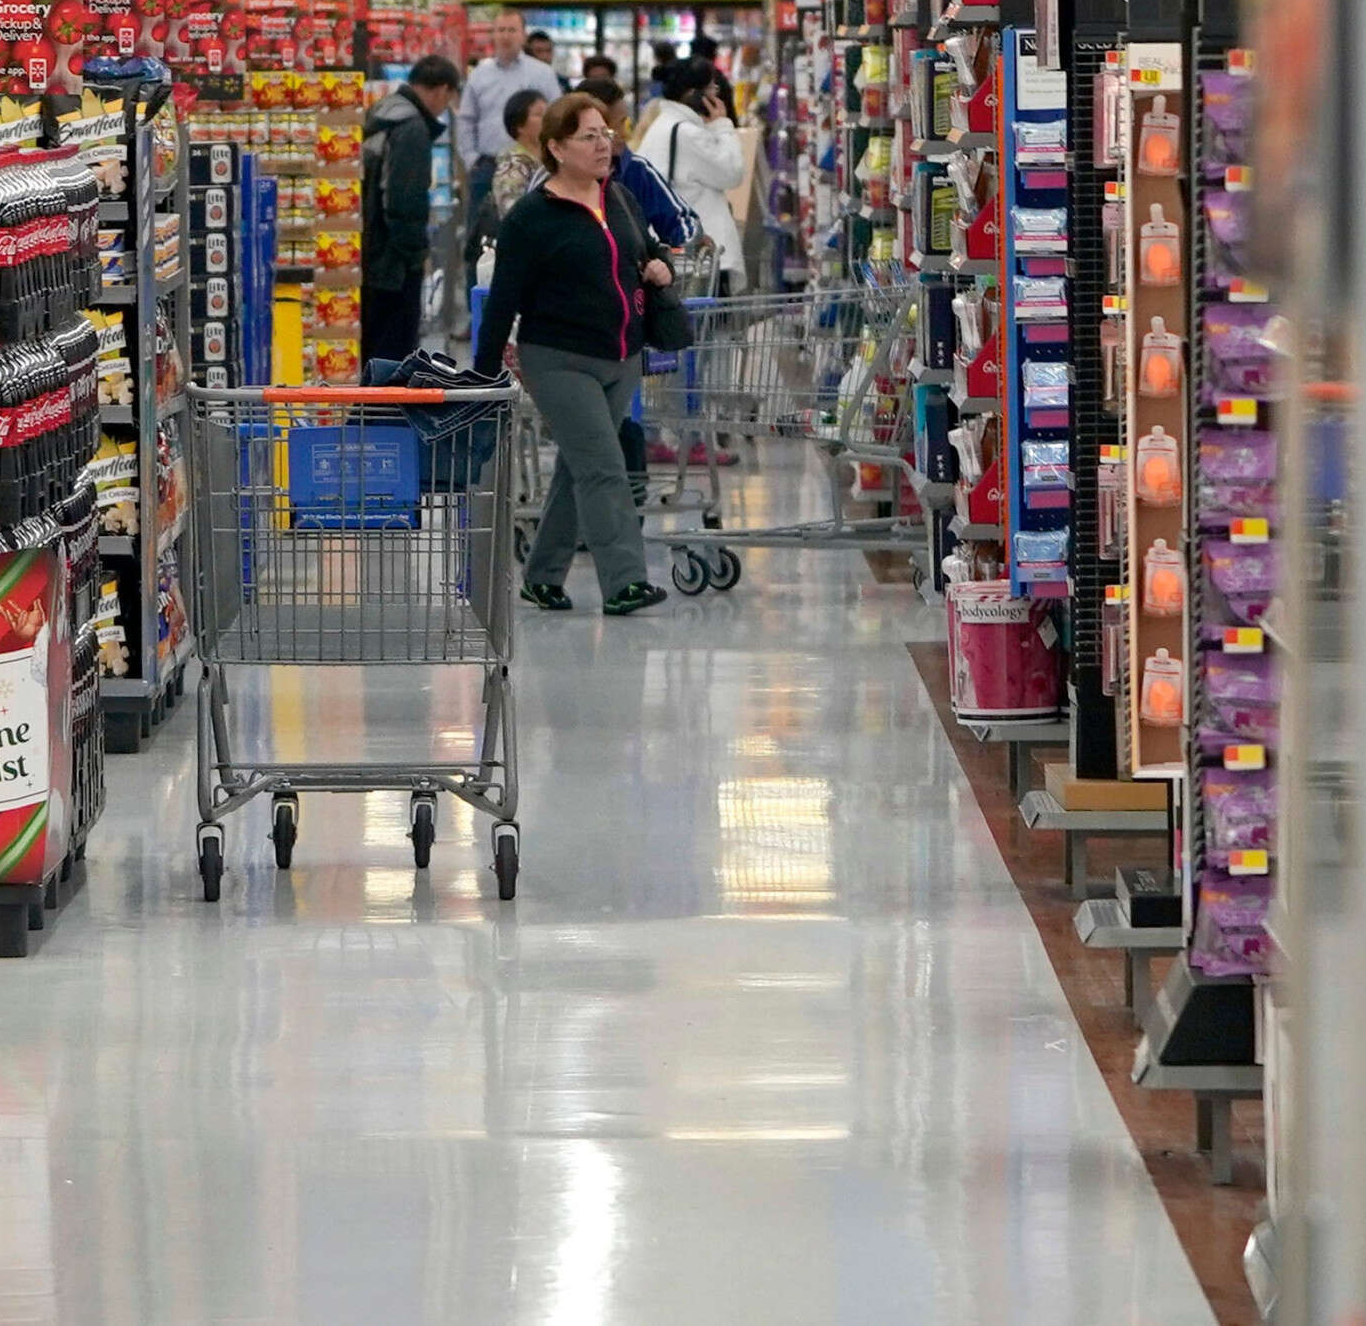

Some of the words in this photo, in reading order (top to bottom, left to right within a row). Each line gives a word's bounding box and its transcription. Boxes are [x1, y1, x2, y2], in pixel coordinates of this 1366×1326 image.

[88, 2, 132, 16] Delivery
[212, 148, 231, 161] Lite
[207, 192, 225, 204] Lite
[207, 236, 226, 249] Lite
[207, 280, 226, 292] Lite
[205, 325, 224, 337] Lite
[207, 369, 226, 382] Lite
[962, 604, 1025, 620] bodycology
